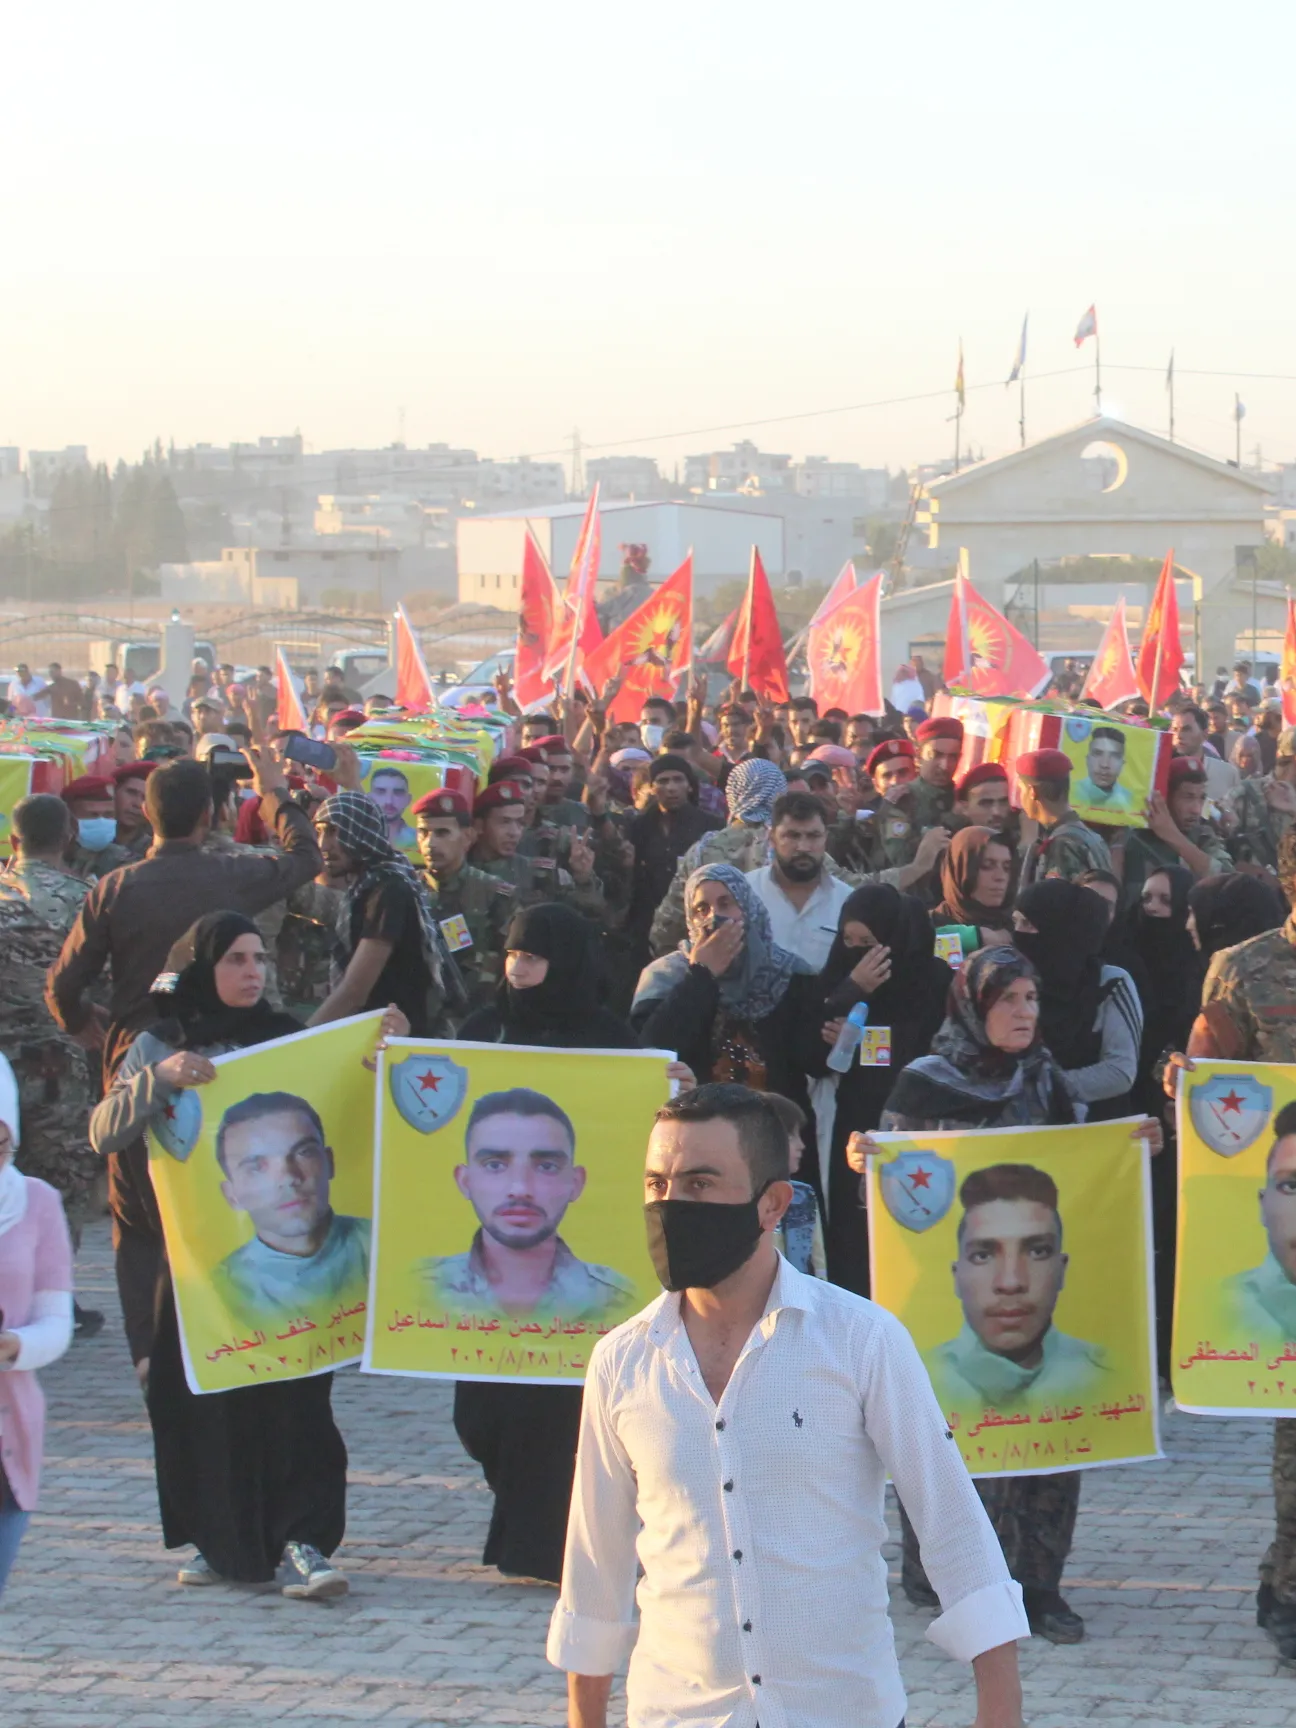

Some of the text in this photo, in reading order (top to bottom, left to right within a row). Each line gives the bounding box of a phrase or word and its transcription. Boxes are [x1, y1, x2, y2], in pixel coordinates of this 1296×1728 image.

[276, 1316, 318, 1341] خلف
[455, 1313, 501, 1337] عبدالله
[206, 1330, 267, 1363] الحاجي
[968, 1407, 1031, 1438] مصطفى
[1038, 1405, 1085, 1425] عبدالله
[965, 1438, 1055, 1469] ٠٢٠/٨/٢٨
